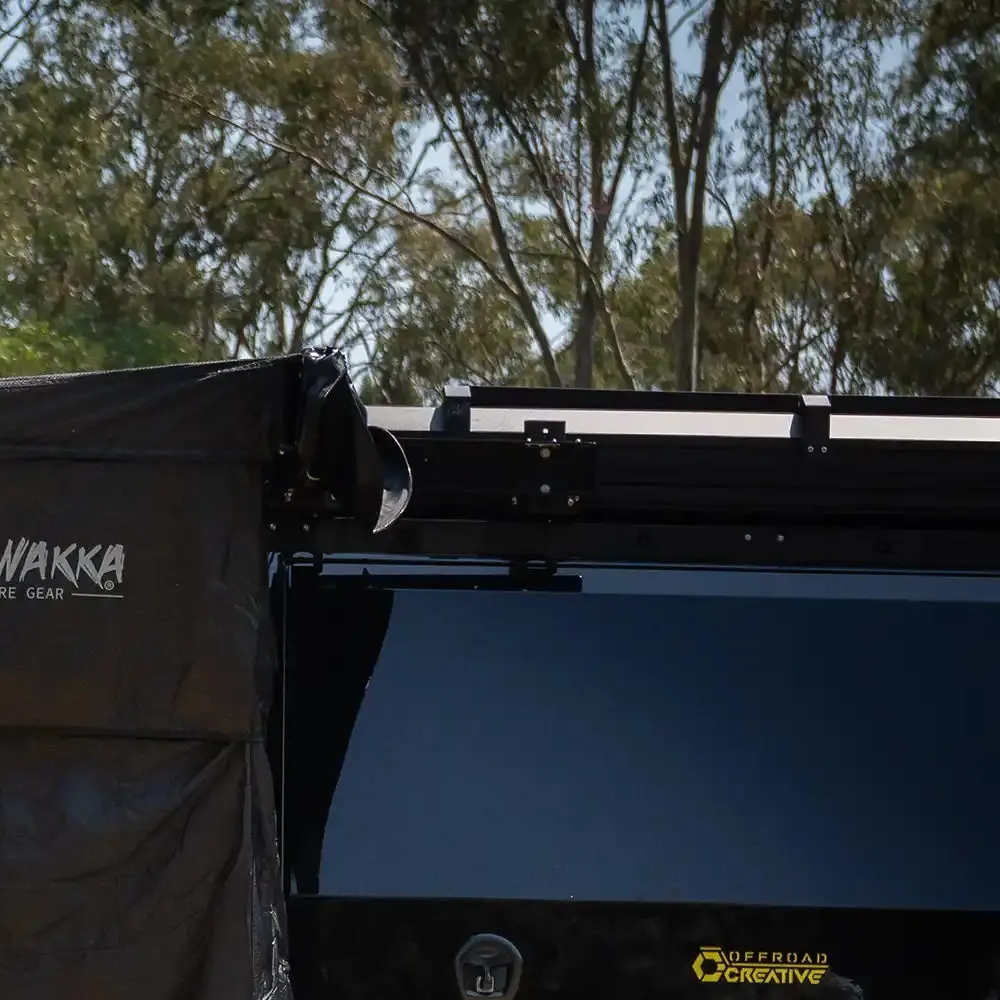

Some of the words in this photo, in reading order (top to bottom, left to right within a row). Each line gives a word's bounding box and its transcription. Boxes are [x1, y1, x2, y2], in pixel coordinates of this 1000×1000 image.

[26, 586, 64, 600] GEAR
[729, 951, 828, 963] OFFROAD
[724, 967, 826, 984] CREATIVE
